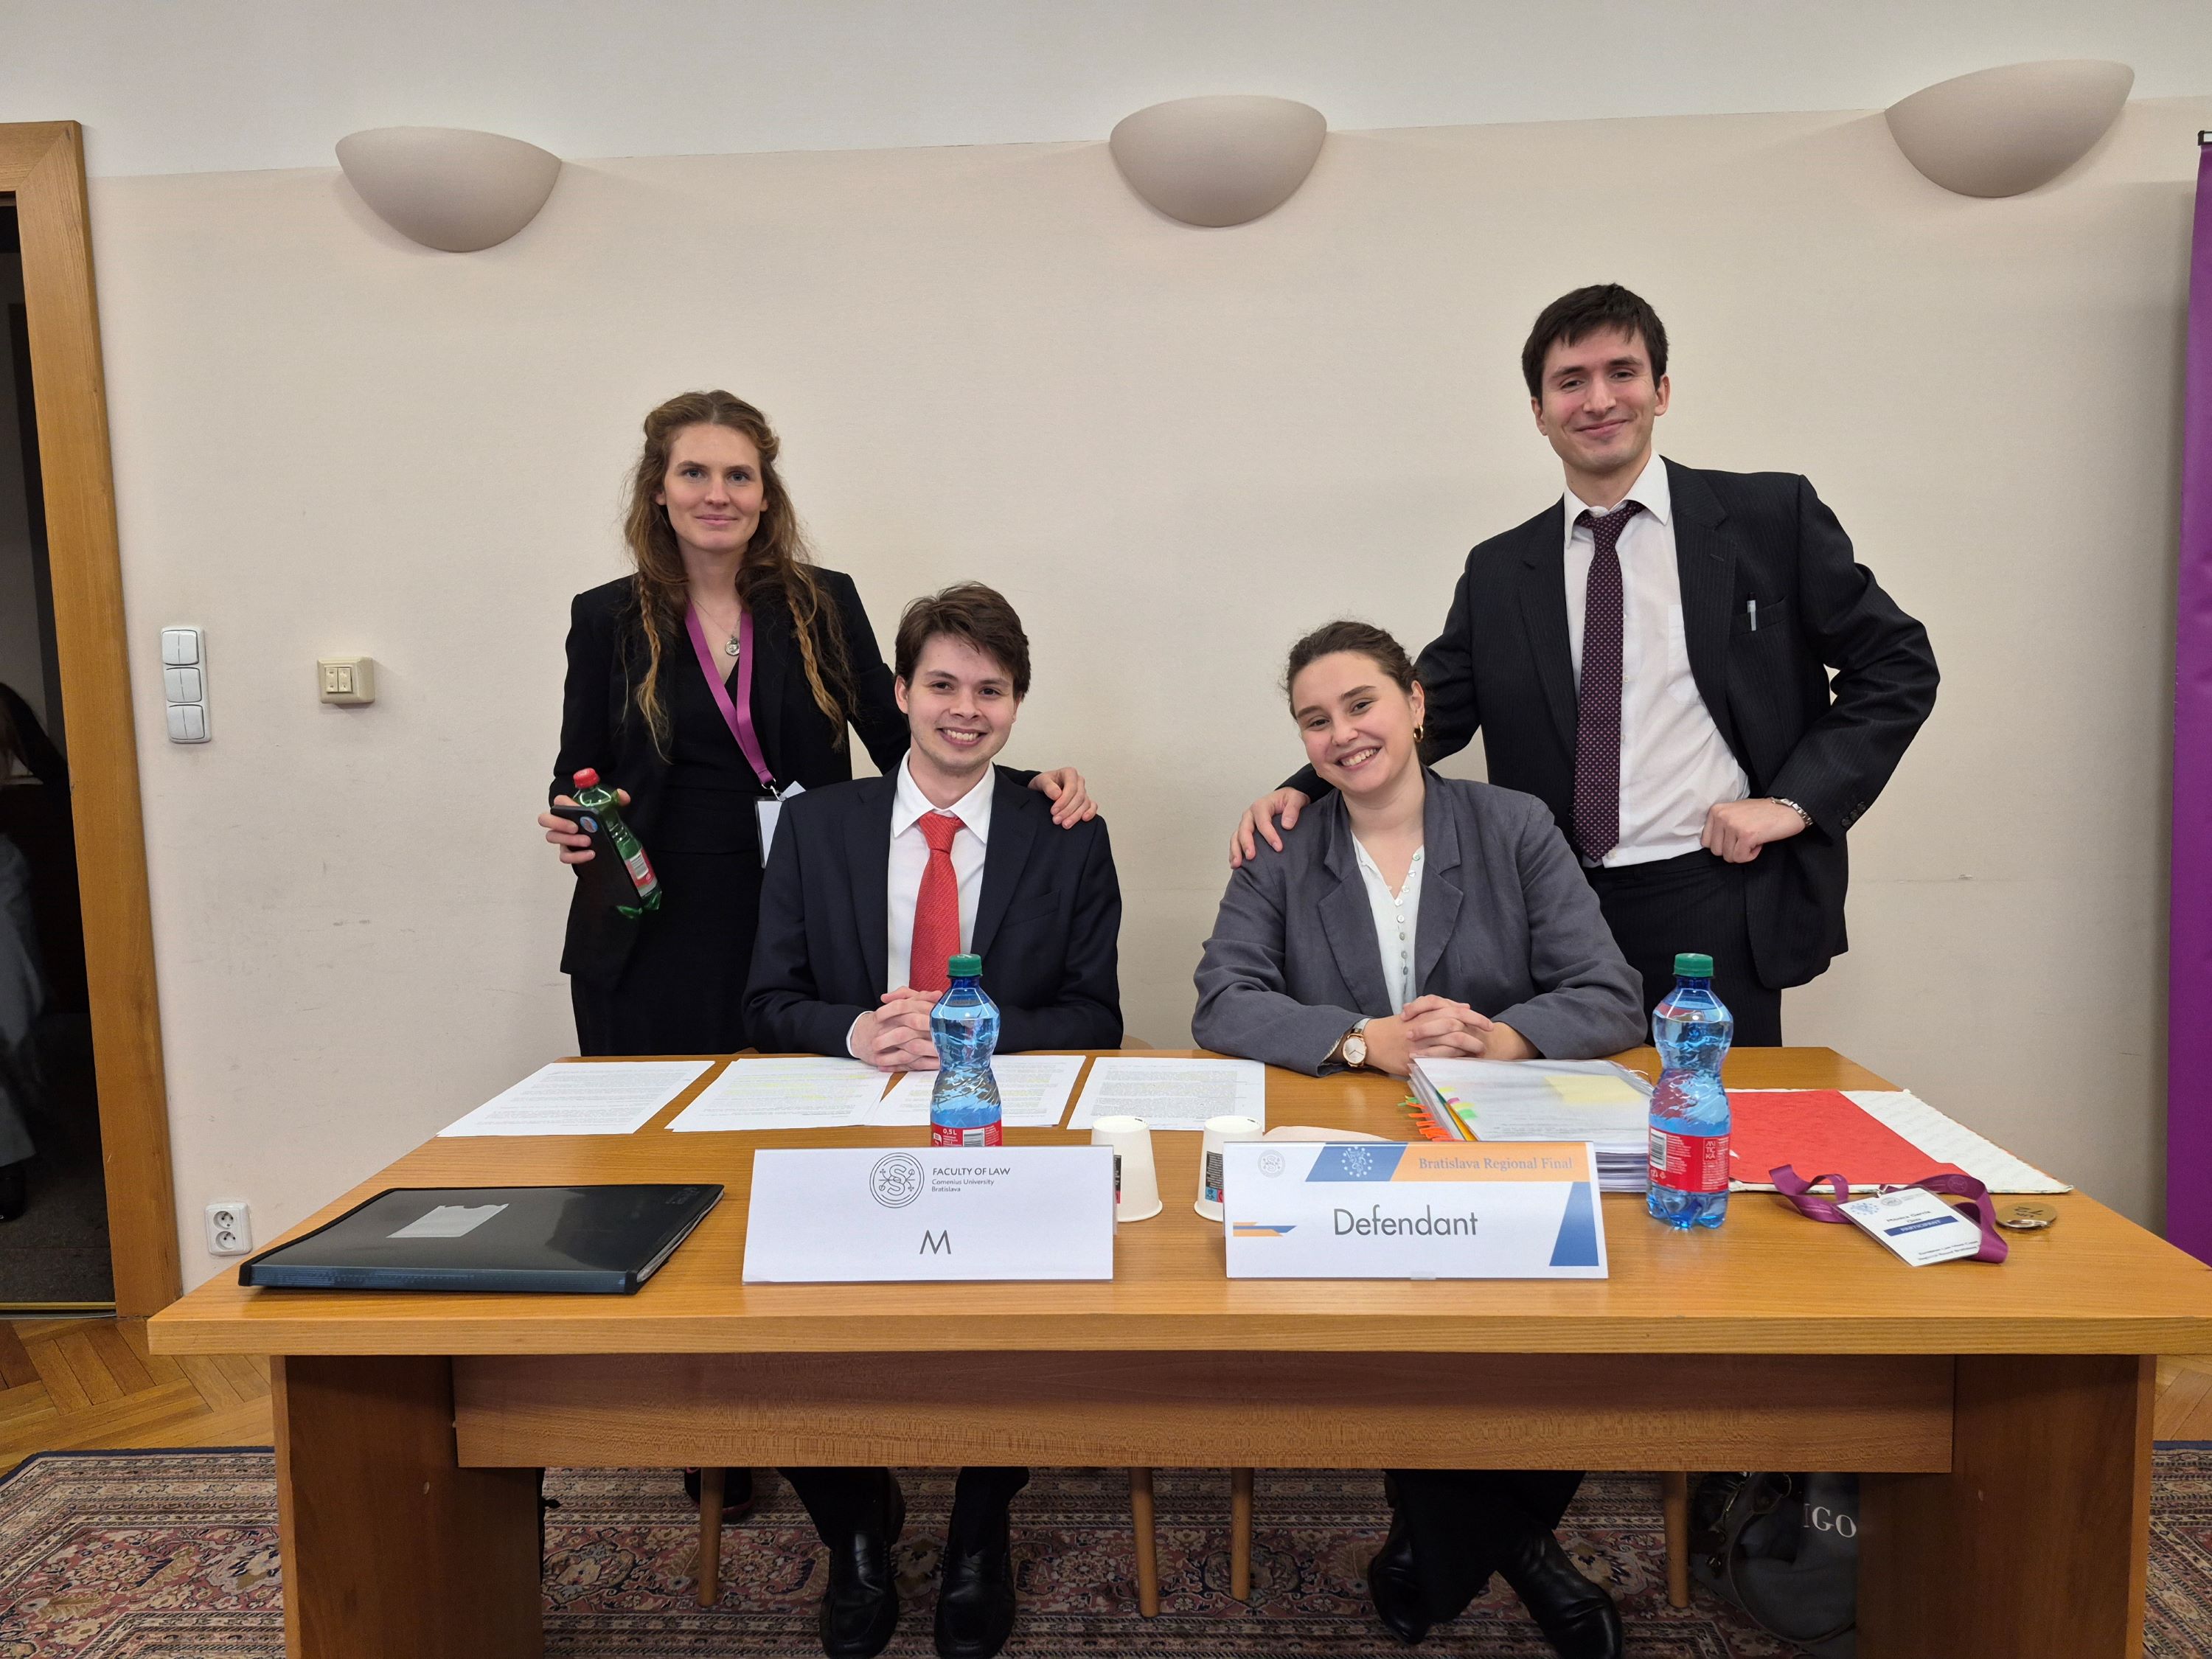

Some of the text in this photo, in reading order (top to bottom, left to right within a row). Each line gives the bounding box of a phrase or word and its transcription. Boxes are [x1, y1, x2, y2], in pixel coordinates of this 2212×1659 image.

[933, 1167, 1011, 1175] FACULTY OF LAW
[1419, 1158, 1573, 1172] Bratislava Regional Final
[964, 1178, 995, 1186] University
[1333, 1204, 1478, 1236] Defendant
[1900, 1220, 1942, 1232] PARTICIPANT
[919, 1229, 952, 1254] M
